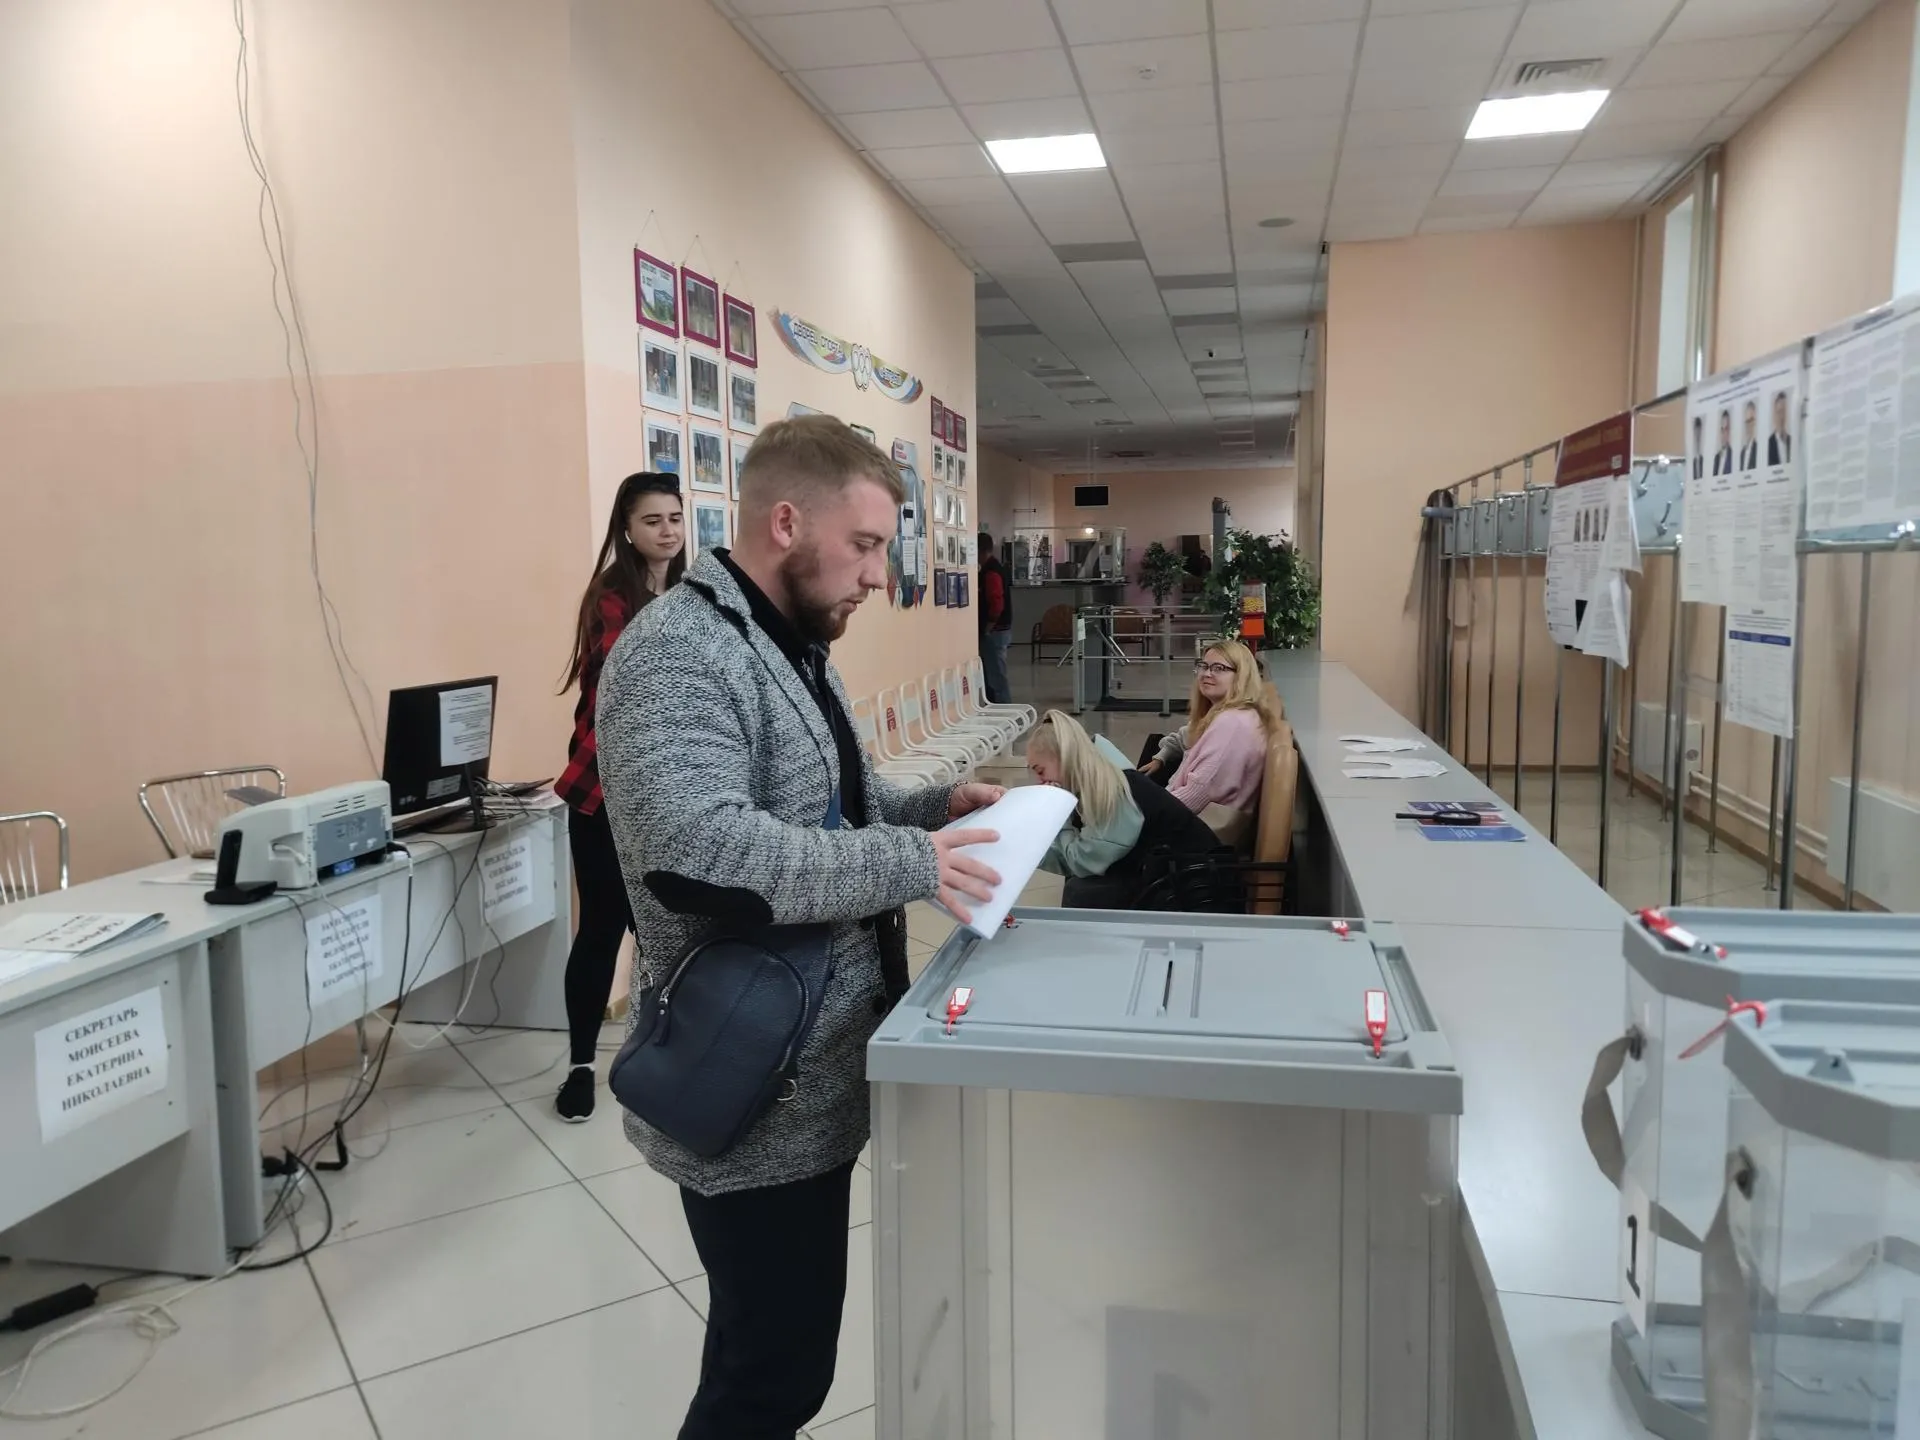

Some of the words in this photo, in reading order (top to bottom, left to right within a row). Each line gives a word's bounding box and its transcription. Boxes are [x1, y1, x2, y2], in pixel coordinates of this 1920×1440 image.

[792, 322, 819, 346] ДВОРЕЦ
[65, 1007, 139, 1043] СЕКРЕТАРЬ
[68, 1028, 140, 1063] МОИСЕЕВА
[66, 1048, 144, 1087] ЕКАТЕРИНА
[62, 1066, 151, 1111] НИКОЛАЕВНА
